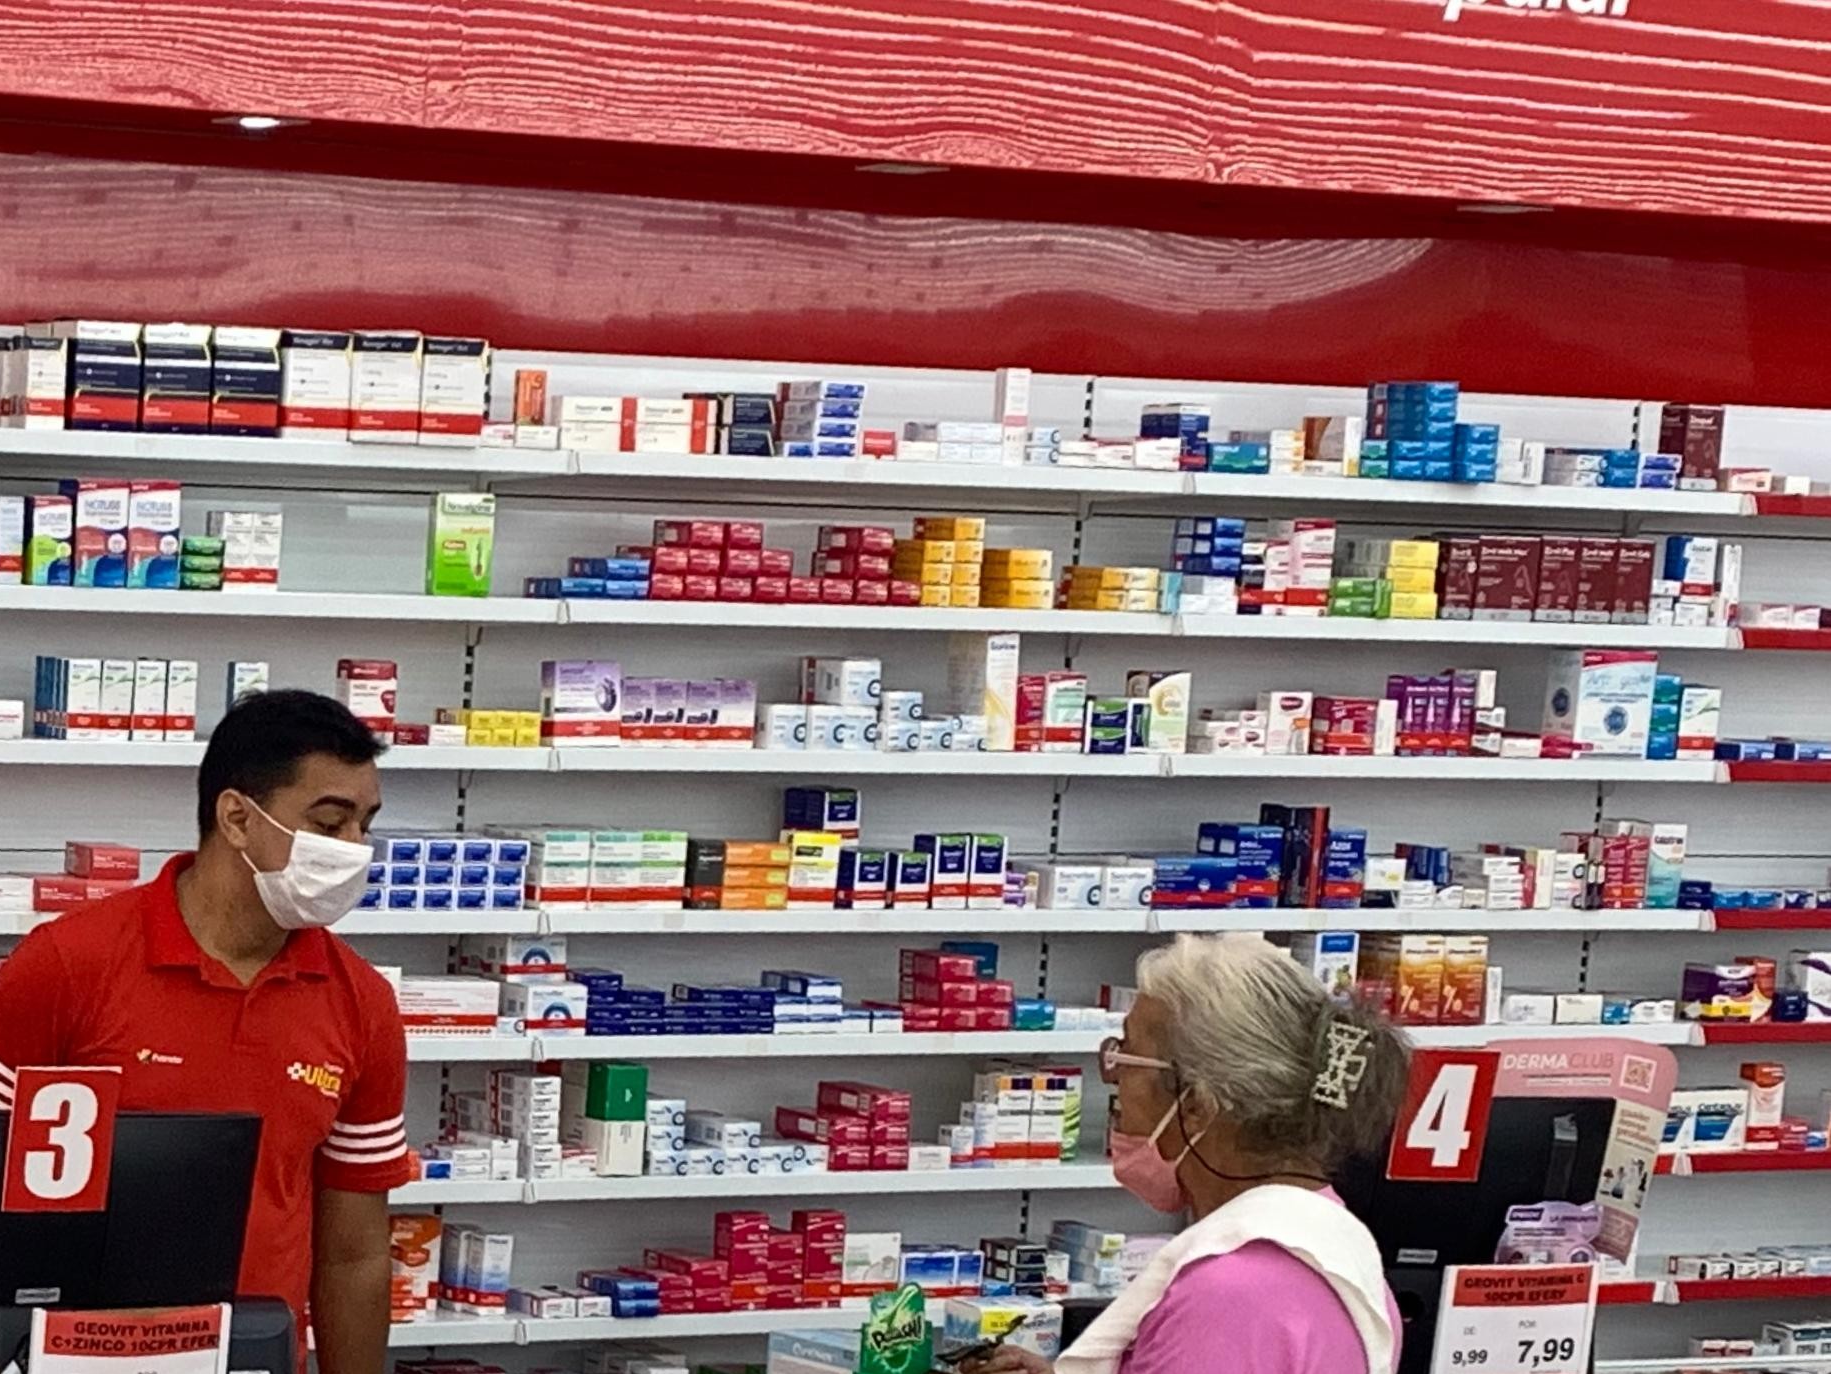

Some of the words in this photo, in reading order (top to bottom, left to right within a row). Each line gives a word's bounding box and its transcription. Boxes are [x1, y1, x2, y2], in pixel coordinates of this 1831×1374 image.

[1406, 1064, 1478, 1168] 4
[24, 1082, 97, 1199] 3
[74, 1321, 137, 1337] GEOVIT
[141, 1320, 210, 1337] VITAMINA
[1452, 1349, 1488, 1367] 9,99
[1517, 1337, 1575, 1368] 7,99
